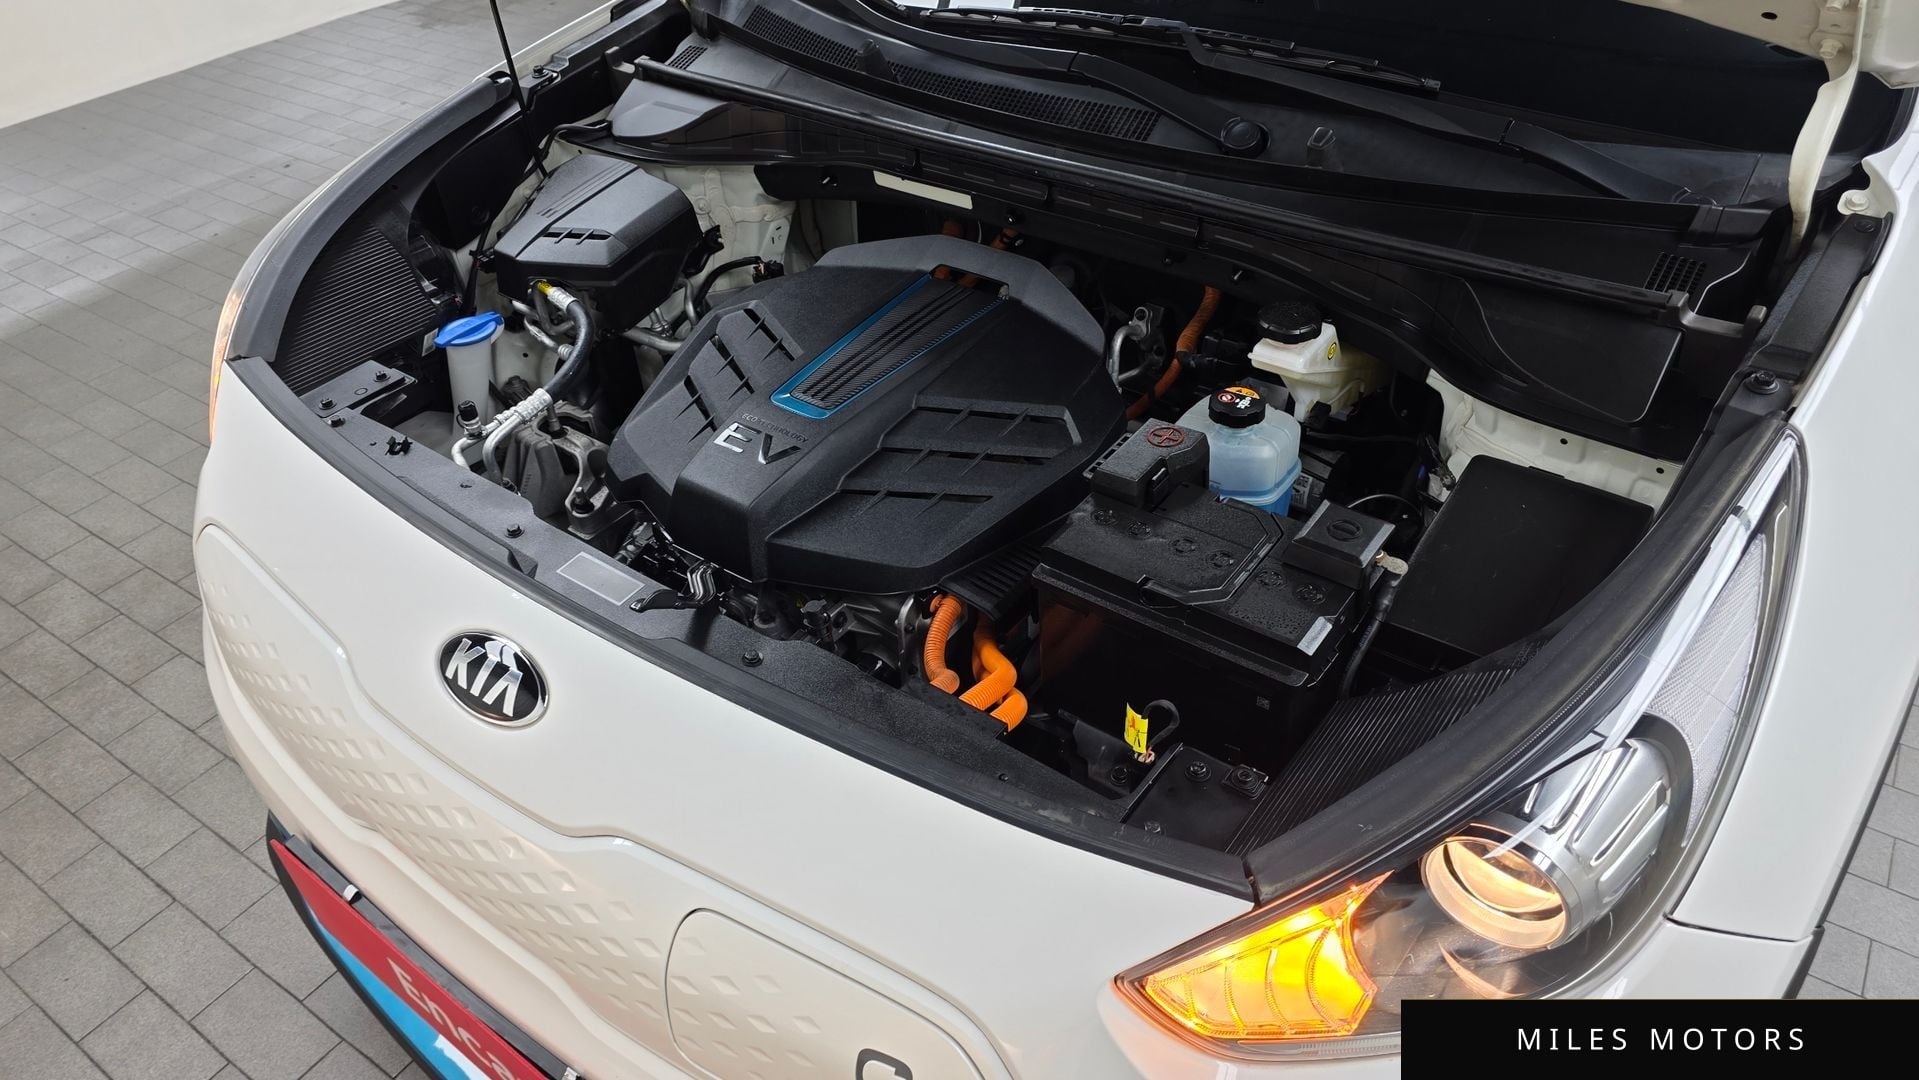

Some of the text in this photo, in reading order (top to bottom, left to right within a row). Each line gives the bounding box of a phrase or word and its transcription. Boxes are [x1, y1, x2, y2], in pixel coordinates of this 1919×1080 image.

[713, 421, 801, 464] EV
[445, 637, 523, 717] KIA
[386, 957, 521, 1080] Enca
